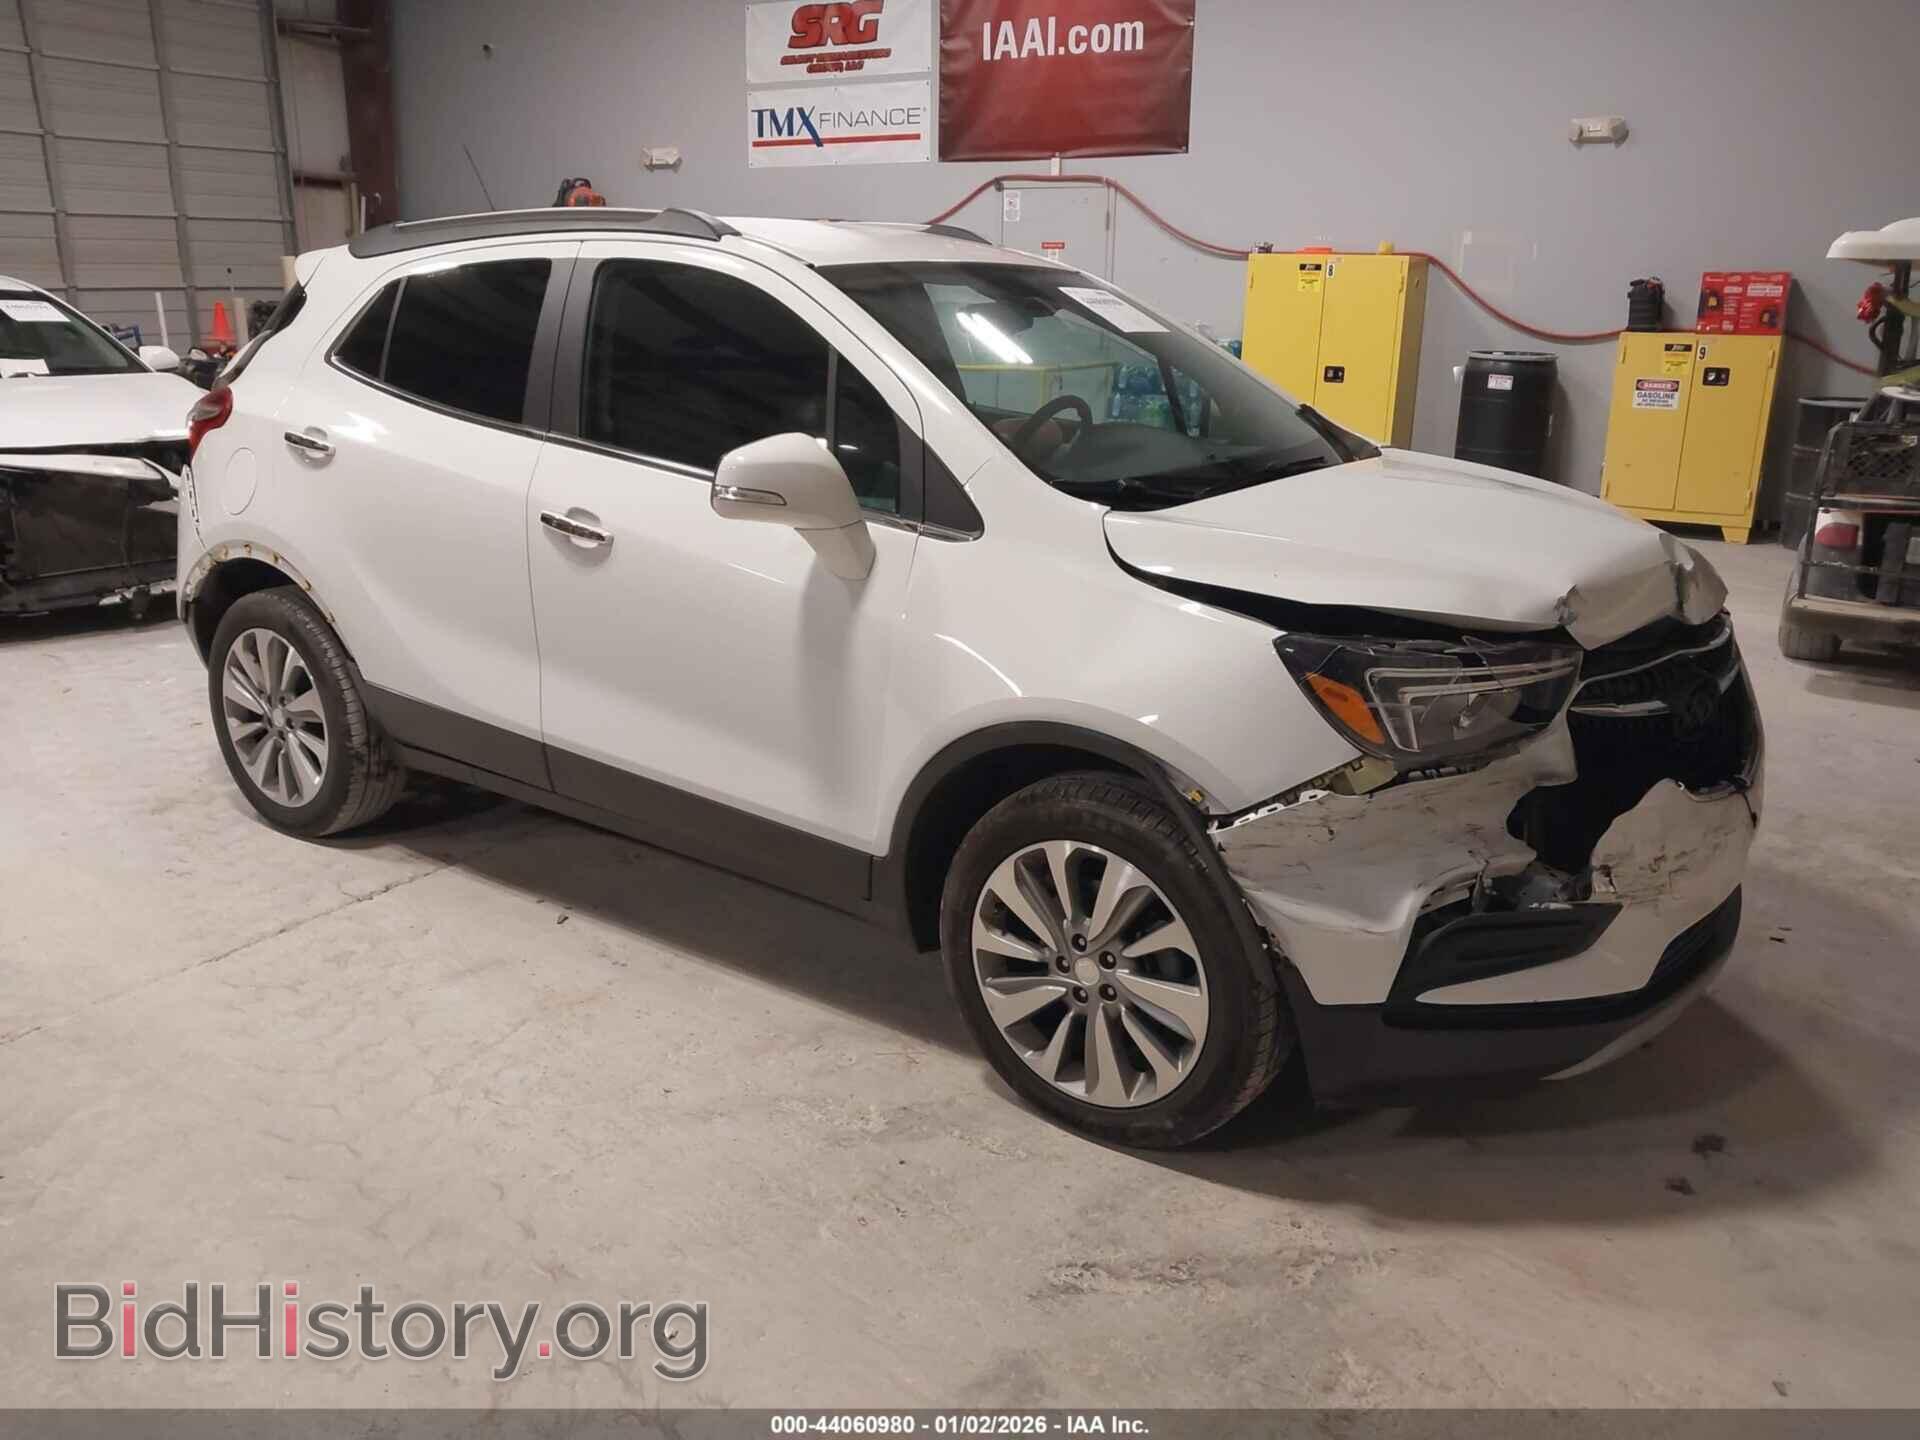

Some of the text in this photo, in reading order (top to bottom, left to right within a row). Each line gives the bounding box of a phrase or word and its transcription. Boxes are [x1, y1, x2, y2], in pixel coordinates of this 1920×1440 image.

[982, 16, 1144, 61] IAAI.com
[751, 106, 921, 147] TMX FINANCE
[1698, 346, 1706, 360] 9
[1637, 391, 1675, 400] GASOLINE
